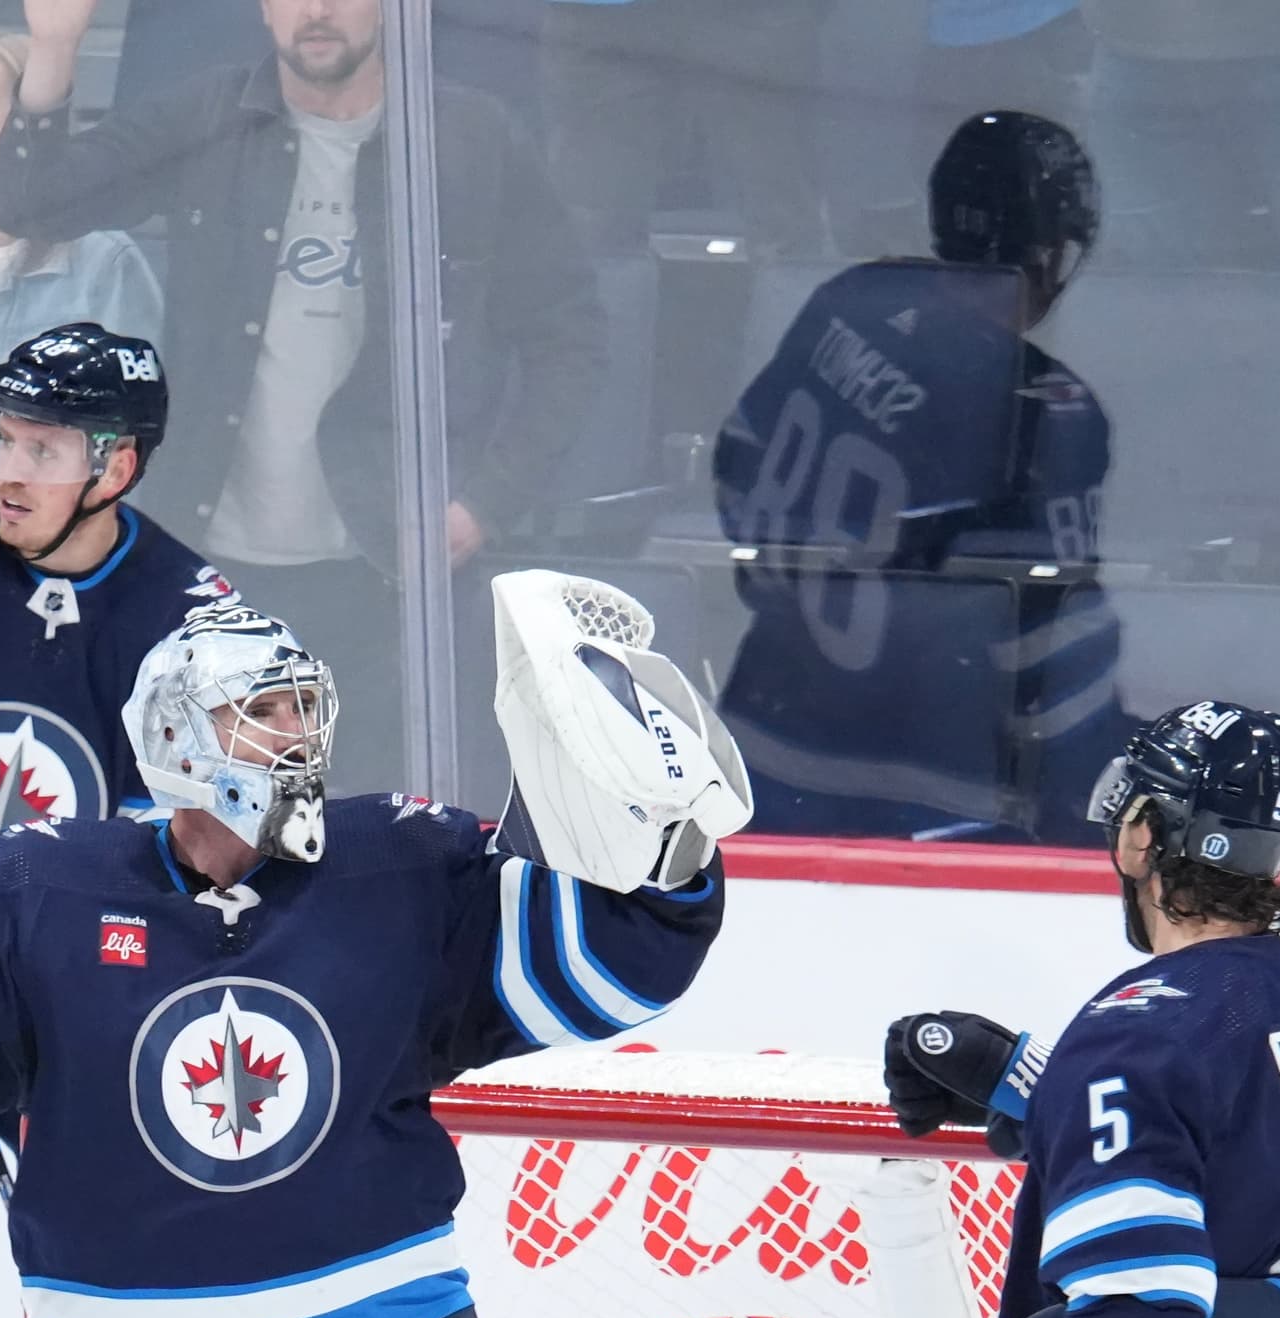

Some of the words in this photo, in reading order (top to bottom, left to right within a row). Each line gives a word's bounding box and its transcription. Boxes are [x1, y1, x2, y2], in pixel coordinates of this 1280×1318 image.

[116, 348, 161, 382] Bell
[0, 376, 43, 397] CCM
[1179, 700, 1241, 740] Bell
[101, 913, 148, 928] canada
[101, 932, 146, 960] life
[1089, 1076, 1131, 1165] 5
